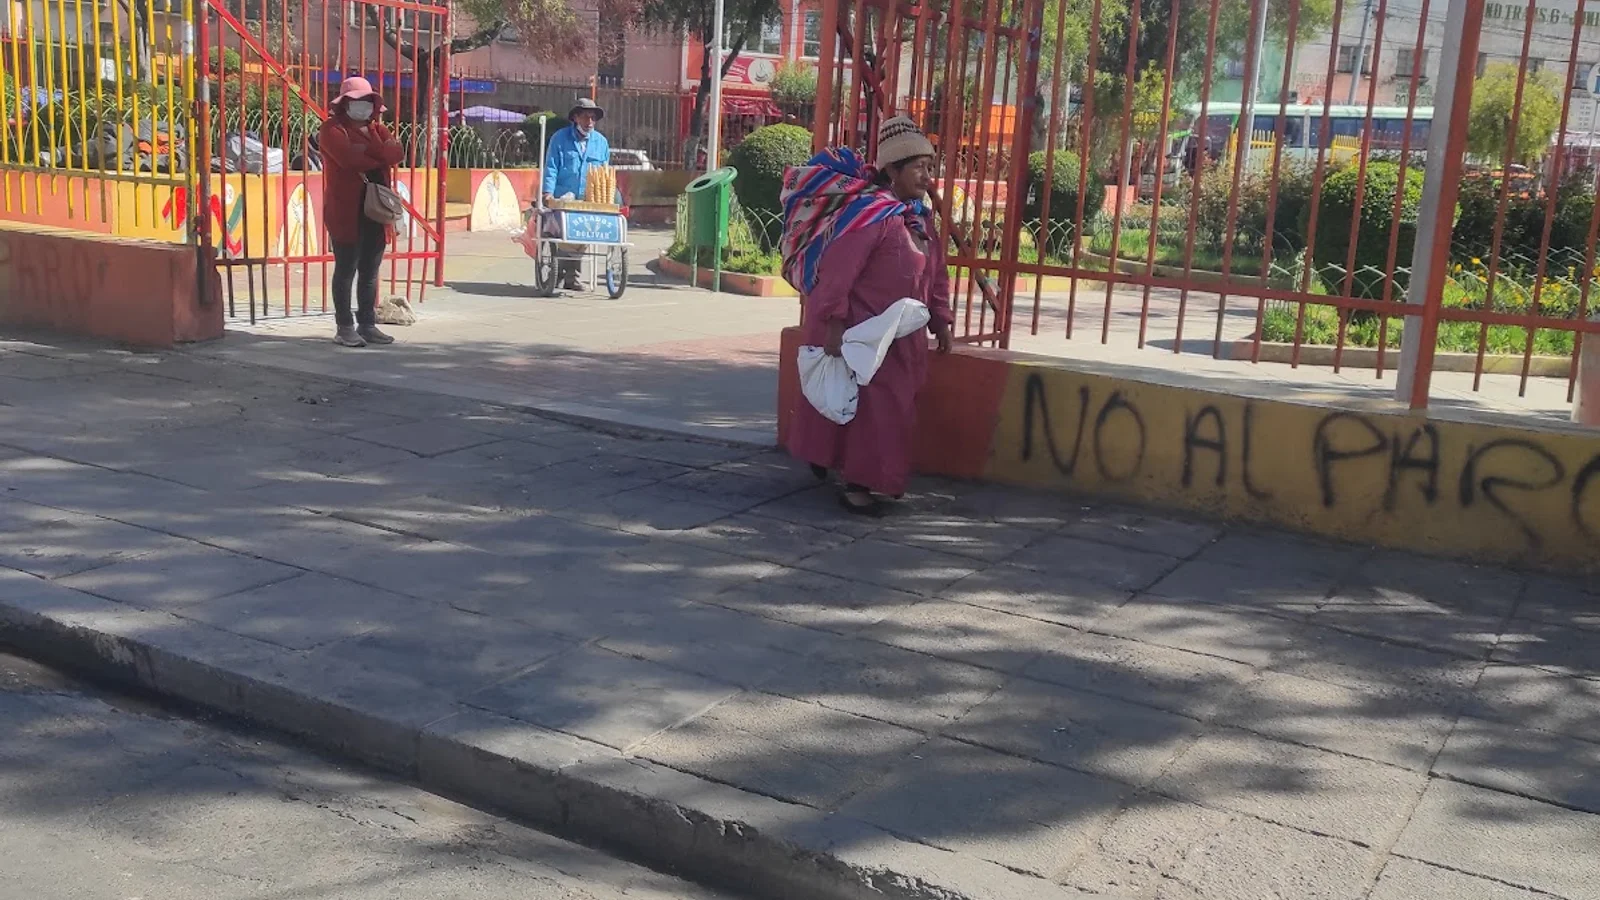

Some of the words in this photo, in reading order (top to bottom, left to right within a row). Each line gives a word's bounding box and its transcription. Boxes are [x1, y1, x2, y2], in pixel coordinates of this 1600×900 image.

[1550, 8, 1560, 24] 6
[572, 215, 613, 229] HELADOS
[1021, 372, 1146, 483] NO
[1181, 400, 1275, 501] AL
